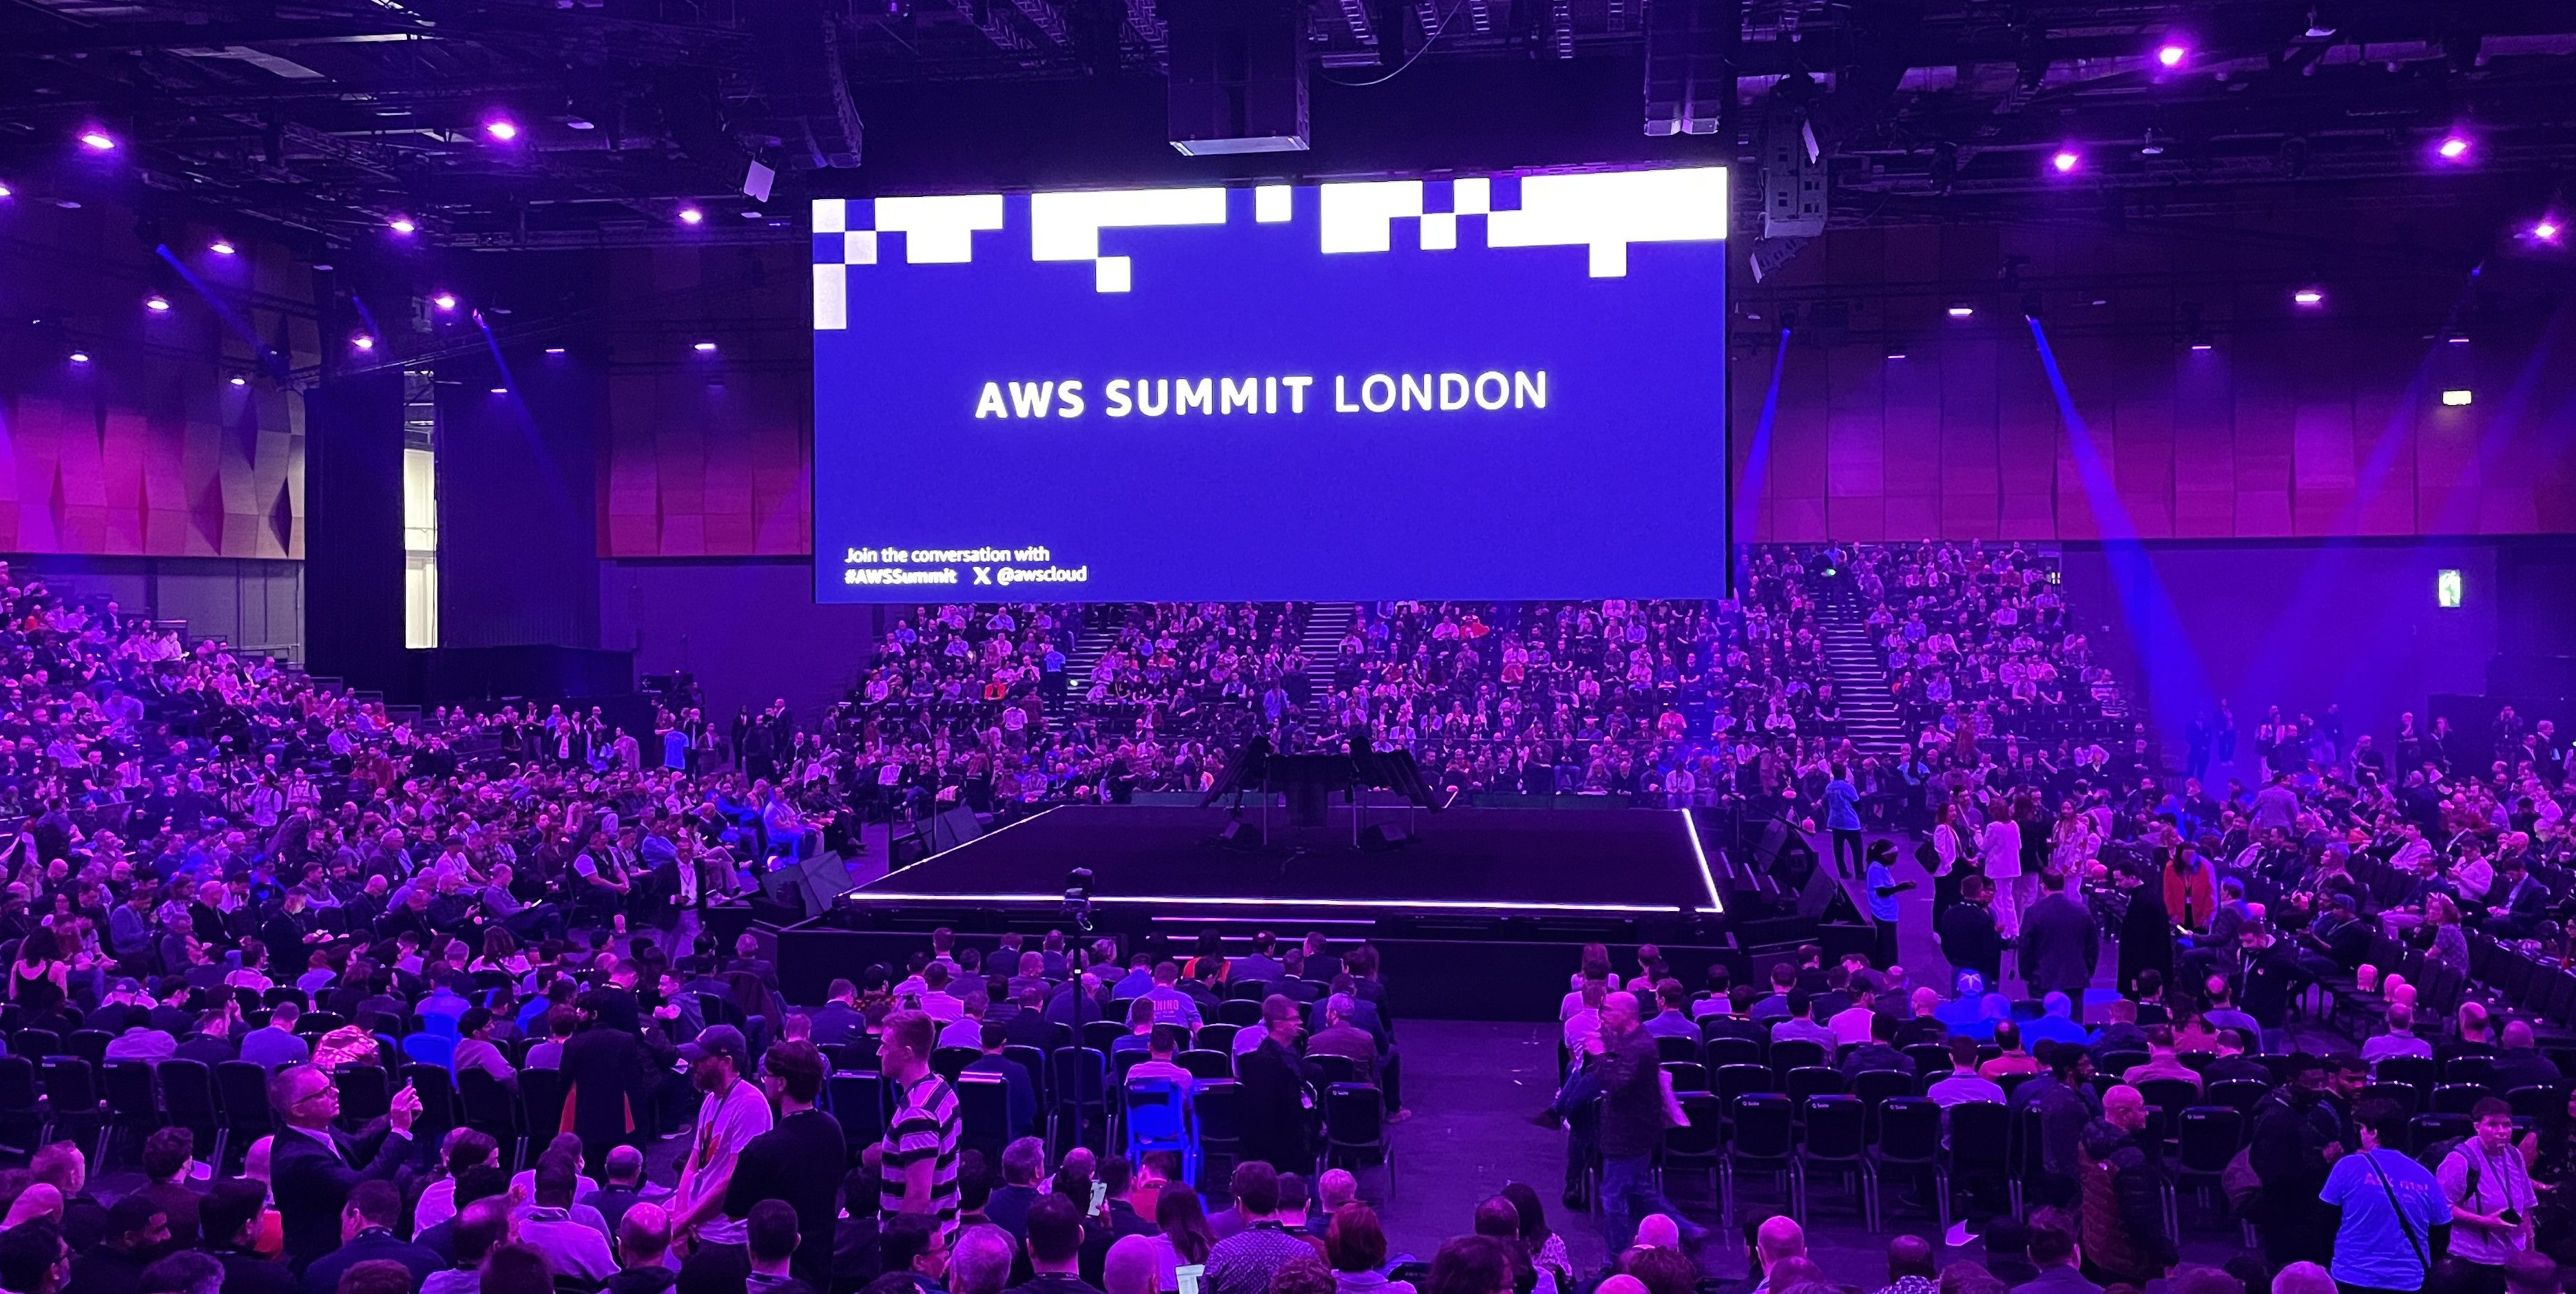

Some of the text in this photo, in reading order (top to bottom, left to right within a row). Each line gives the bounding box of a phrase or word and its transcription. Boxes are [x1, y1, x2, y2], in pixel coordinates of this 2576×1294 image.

[975, 370, 1547, 419] AWS SUMMIT LONDON
[844, 545, 1052, 563] Join the conversation with
[844, 567, 958, 585] #AWSSummit
[996, 565, 1088, 586] @awscloud
